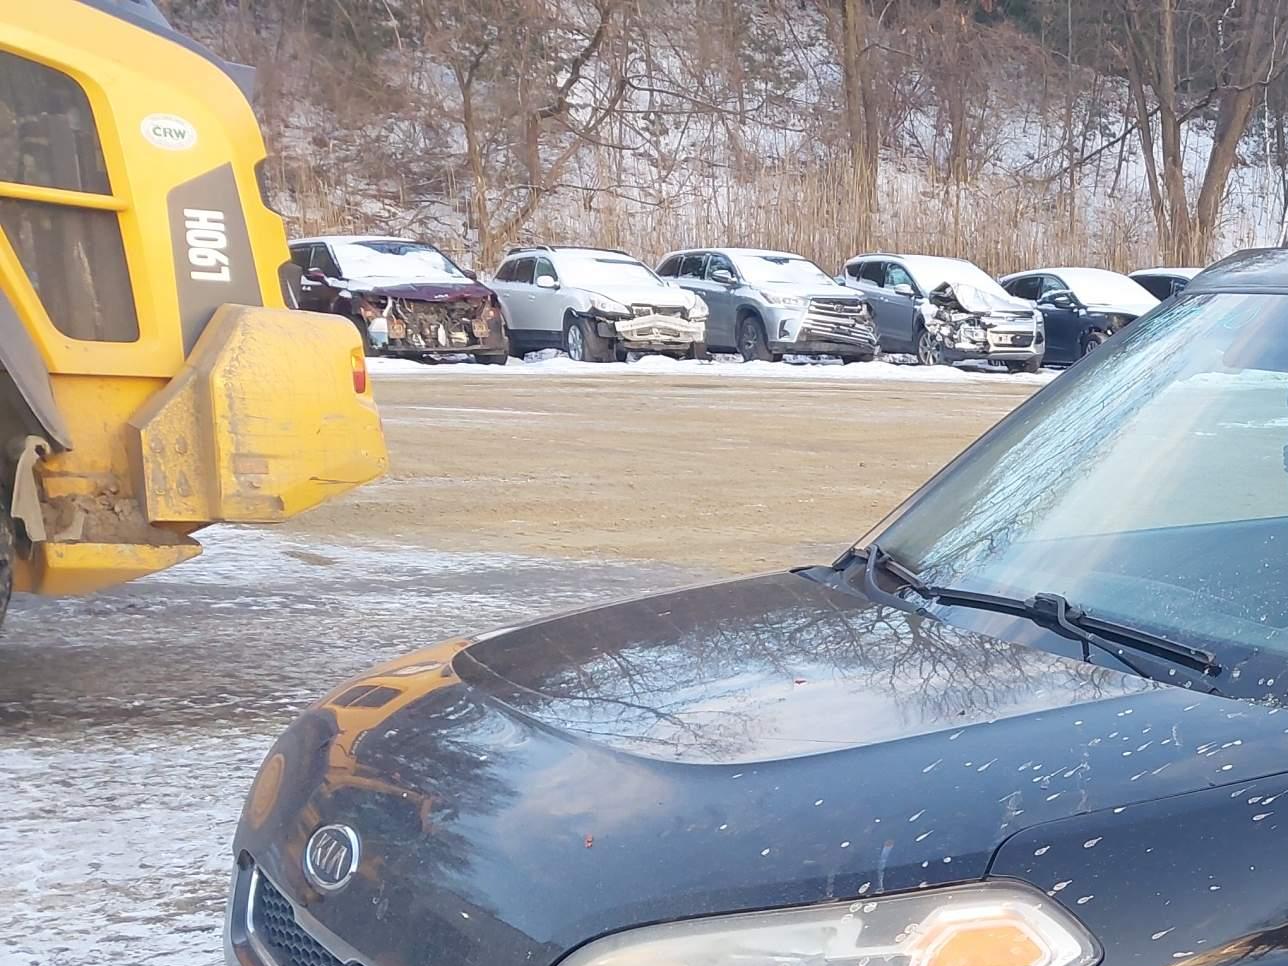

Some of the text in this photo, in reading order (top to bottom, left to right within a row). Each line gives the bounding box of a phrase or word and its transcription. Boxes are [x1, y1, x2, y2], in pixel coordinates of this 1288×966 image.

[152, 126, 186, 140] CRW
[184, 208, 231, 282] L90H
[312, 832, 348, 880] KIA
